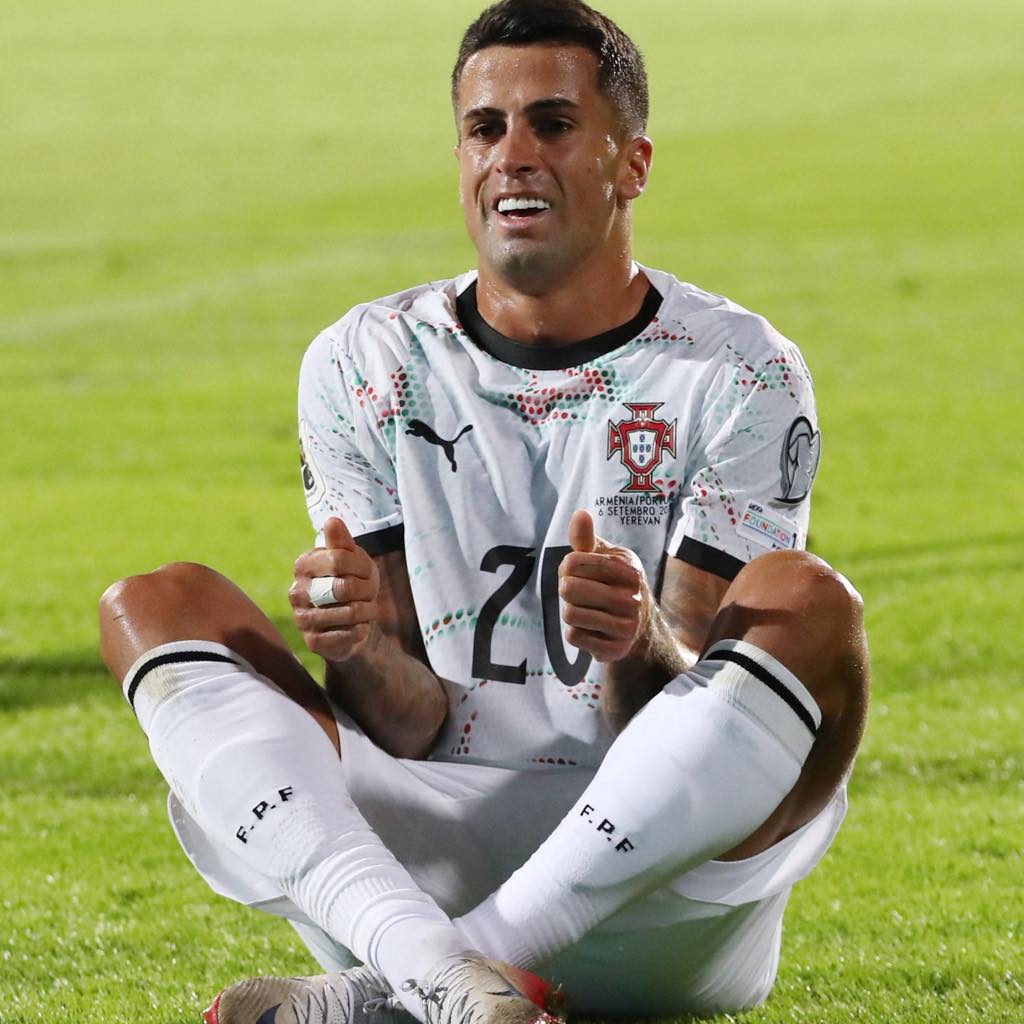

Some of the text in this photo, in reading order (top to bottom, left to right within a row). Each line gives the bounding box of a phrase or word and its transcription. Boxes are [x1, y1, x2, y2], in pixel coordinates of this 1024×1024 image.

[598, 508, 604, 517] 6
[607, 506, 656, 516] SETEMBRO
[620, 515, 661, 526] YEREVAN
